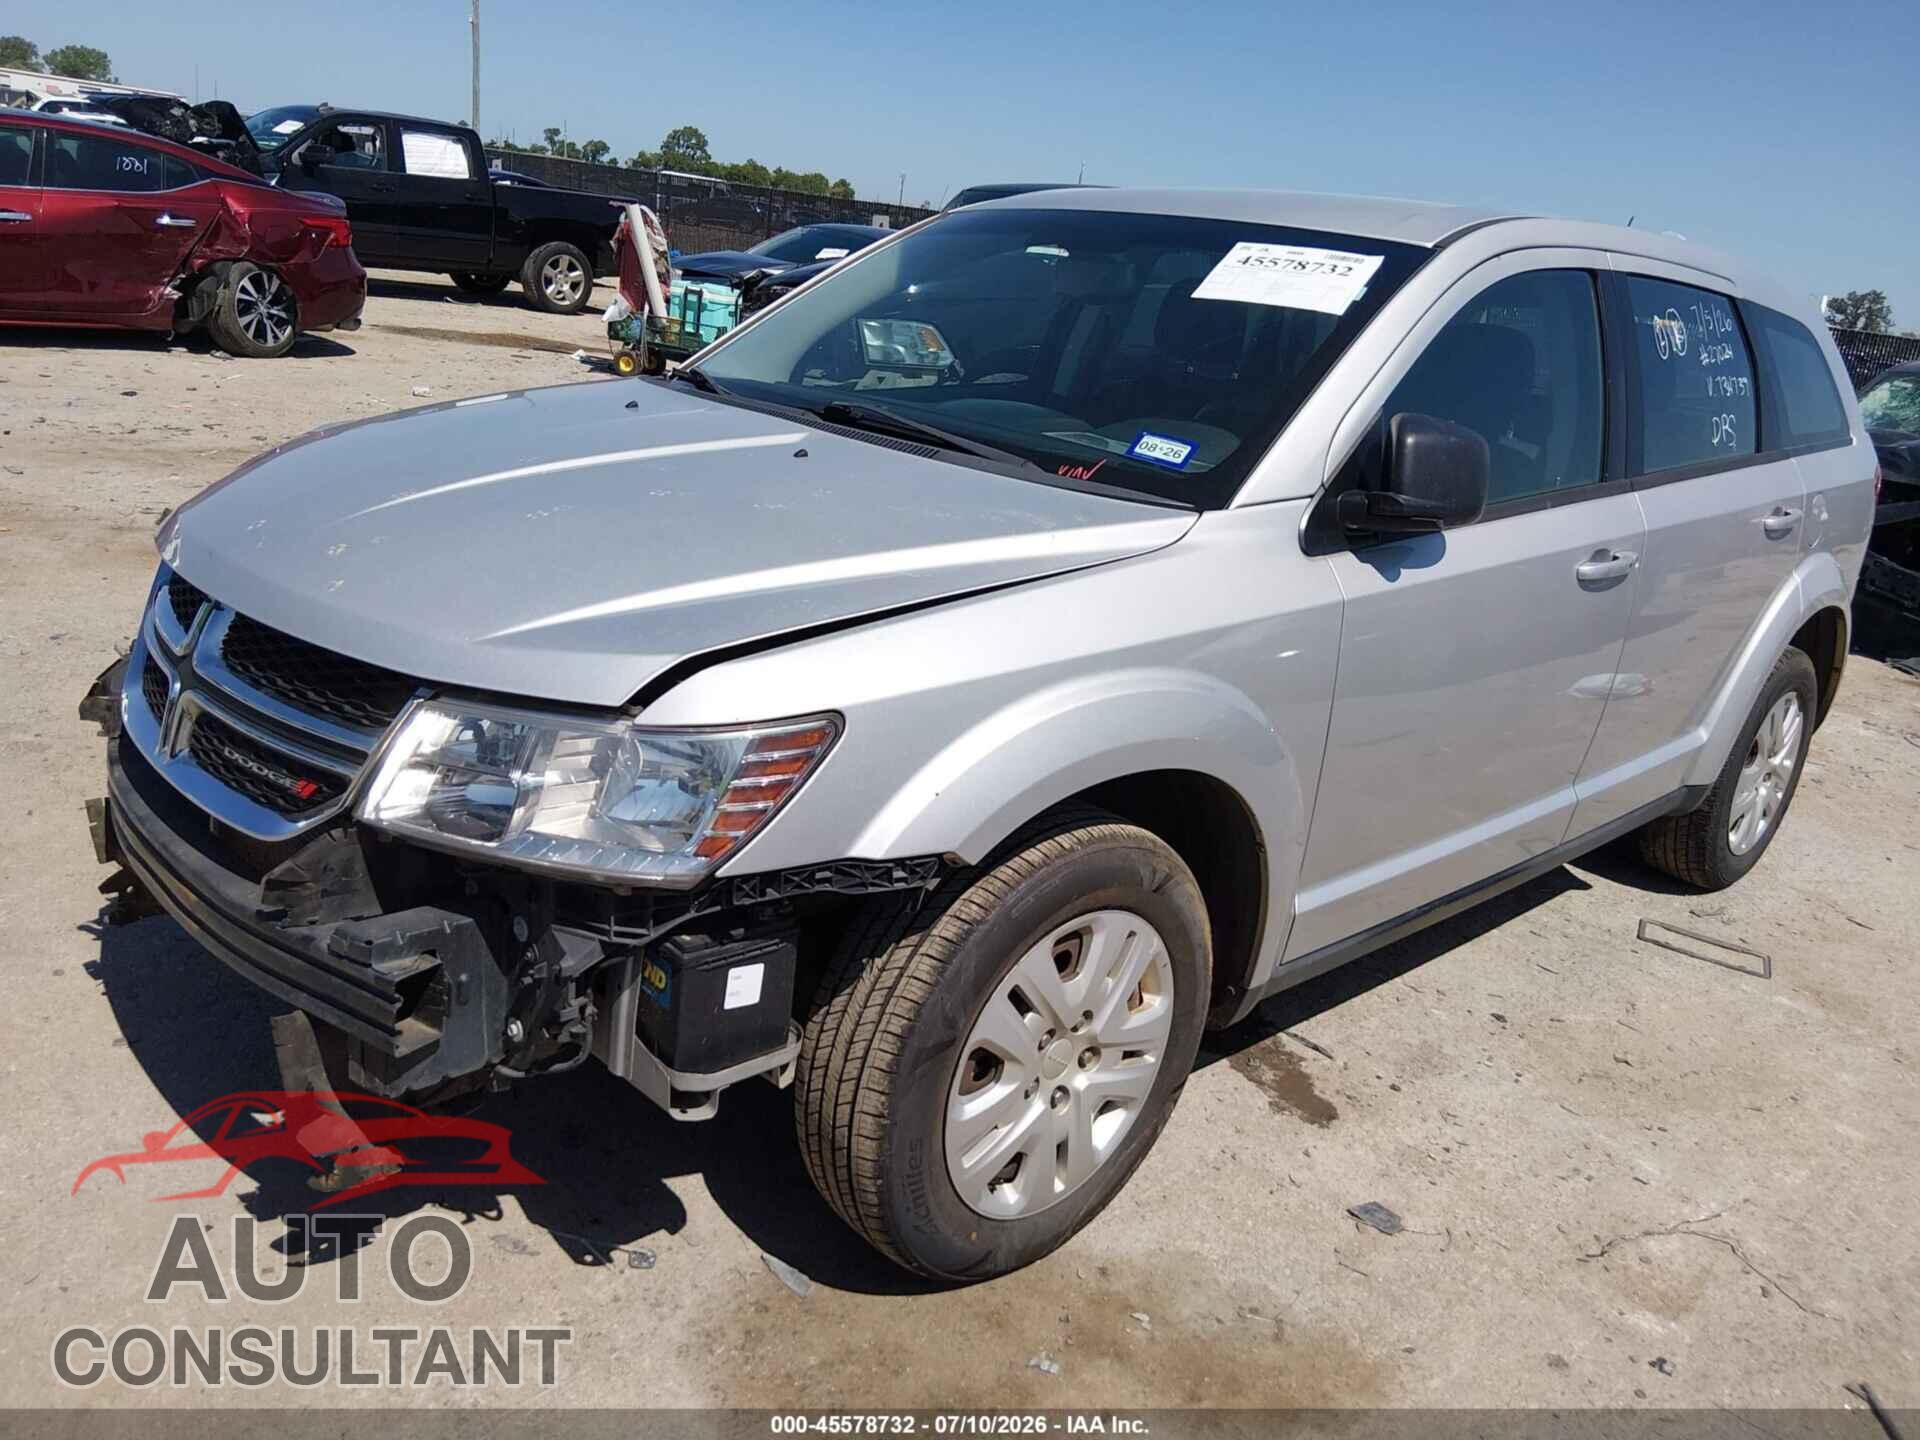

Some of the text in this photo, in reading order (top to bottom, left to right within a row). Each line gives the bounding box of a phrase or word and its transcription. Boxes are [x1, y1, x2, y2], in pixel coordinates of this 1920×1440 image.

[1237, 255, 1353, 277] 45578732
[1138, 440, 1158, 453] 08
[1162, 446, 1184, 460] 26
[223, 746, 301, 793] DODGE
